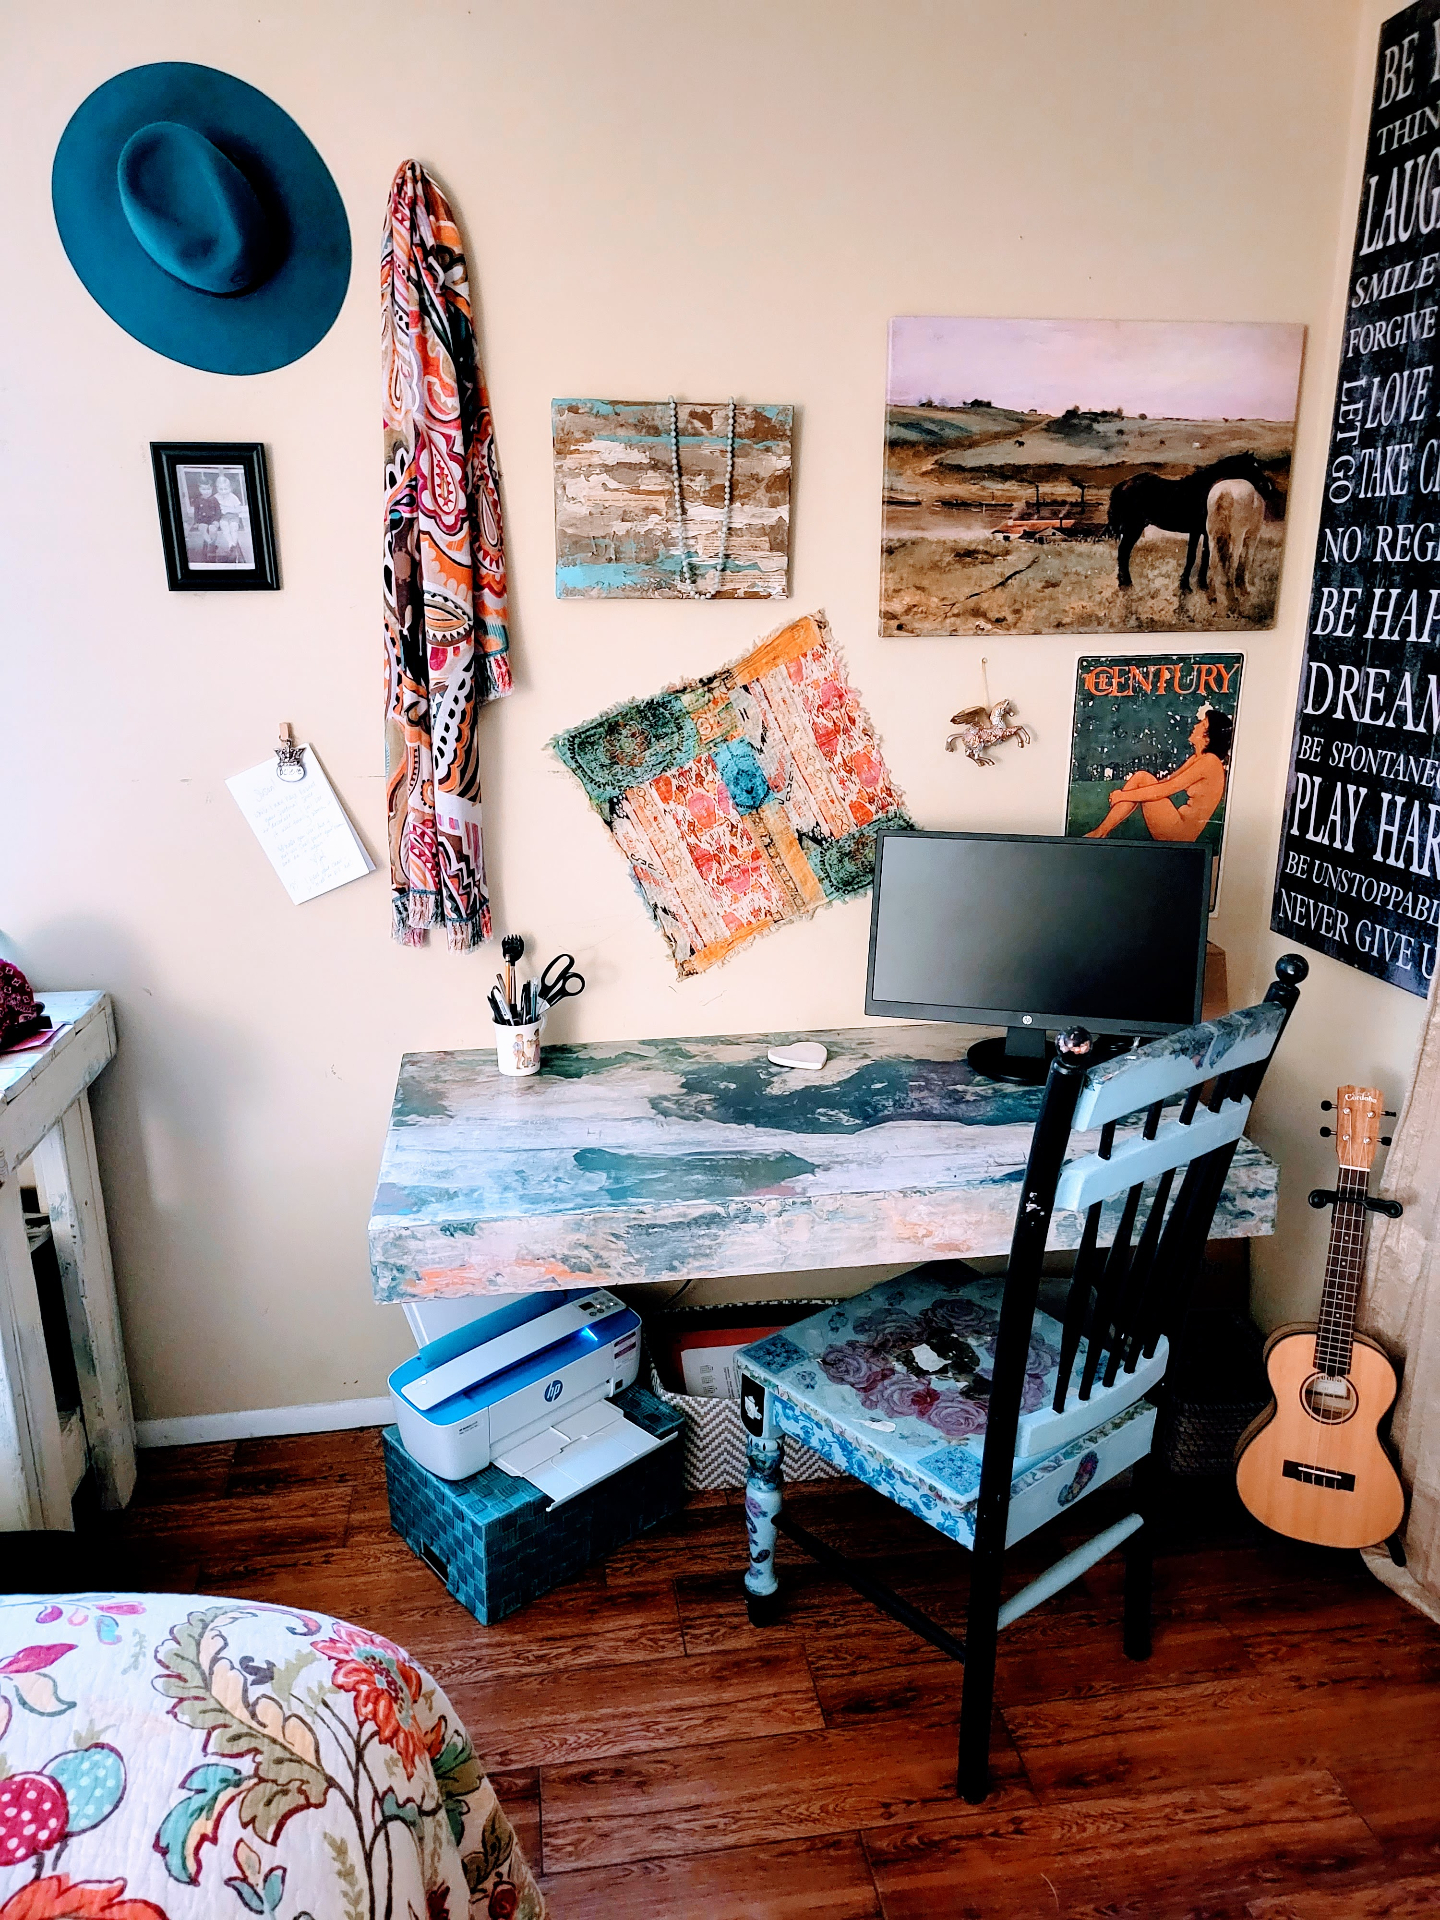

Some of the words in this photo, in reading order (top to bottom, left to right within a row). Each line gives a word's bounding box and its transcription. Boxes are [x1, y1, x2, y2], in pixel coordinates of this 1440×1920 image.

[1379, 31, 1419, 110] BE
[1360, 147, 1440, 256] LAUG
[1351, 252, 1440, 309] SMILE
[1346, 306, 1439, 358] FORGIVE
[1336, 377, 1366, 446] LET
[1364, 365, 1434, 429] LOVE
[1328, 455, 1356, 504] GO
[1358, 443, 1413, 499] TAKE
[1321, 526, 1362, 563] NO
[1373, 522, 1440, 563] REG
[1313, 587, 1362, 637] BE
[1087, 663, 1240, 696] CENTURY
[1298, 735, 1325, 763] BE
[1329, 741, 1440, 789] SPONTANE
[1290, 772, 1368, 853] PLAY
[1285, 851, 1309, 879] BE
[1279, 888, 1349, 945] NEVER
[1355, 919, 1415, 971] GIVE
[545, 1381, 562, 1402] hp
